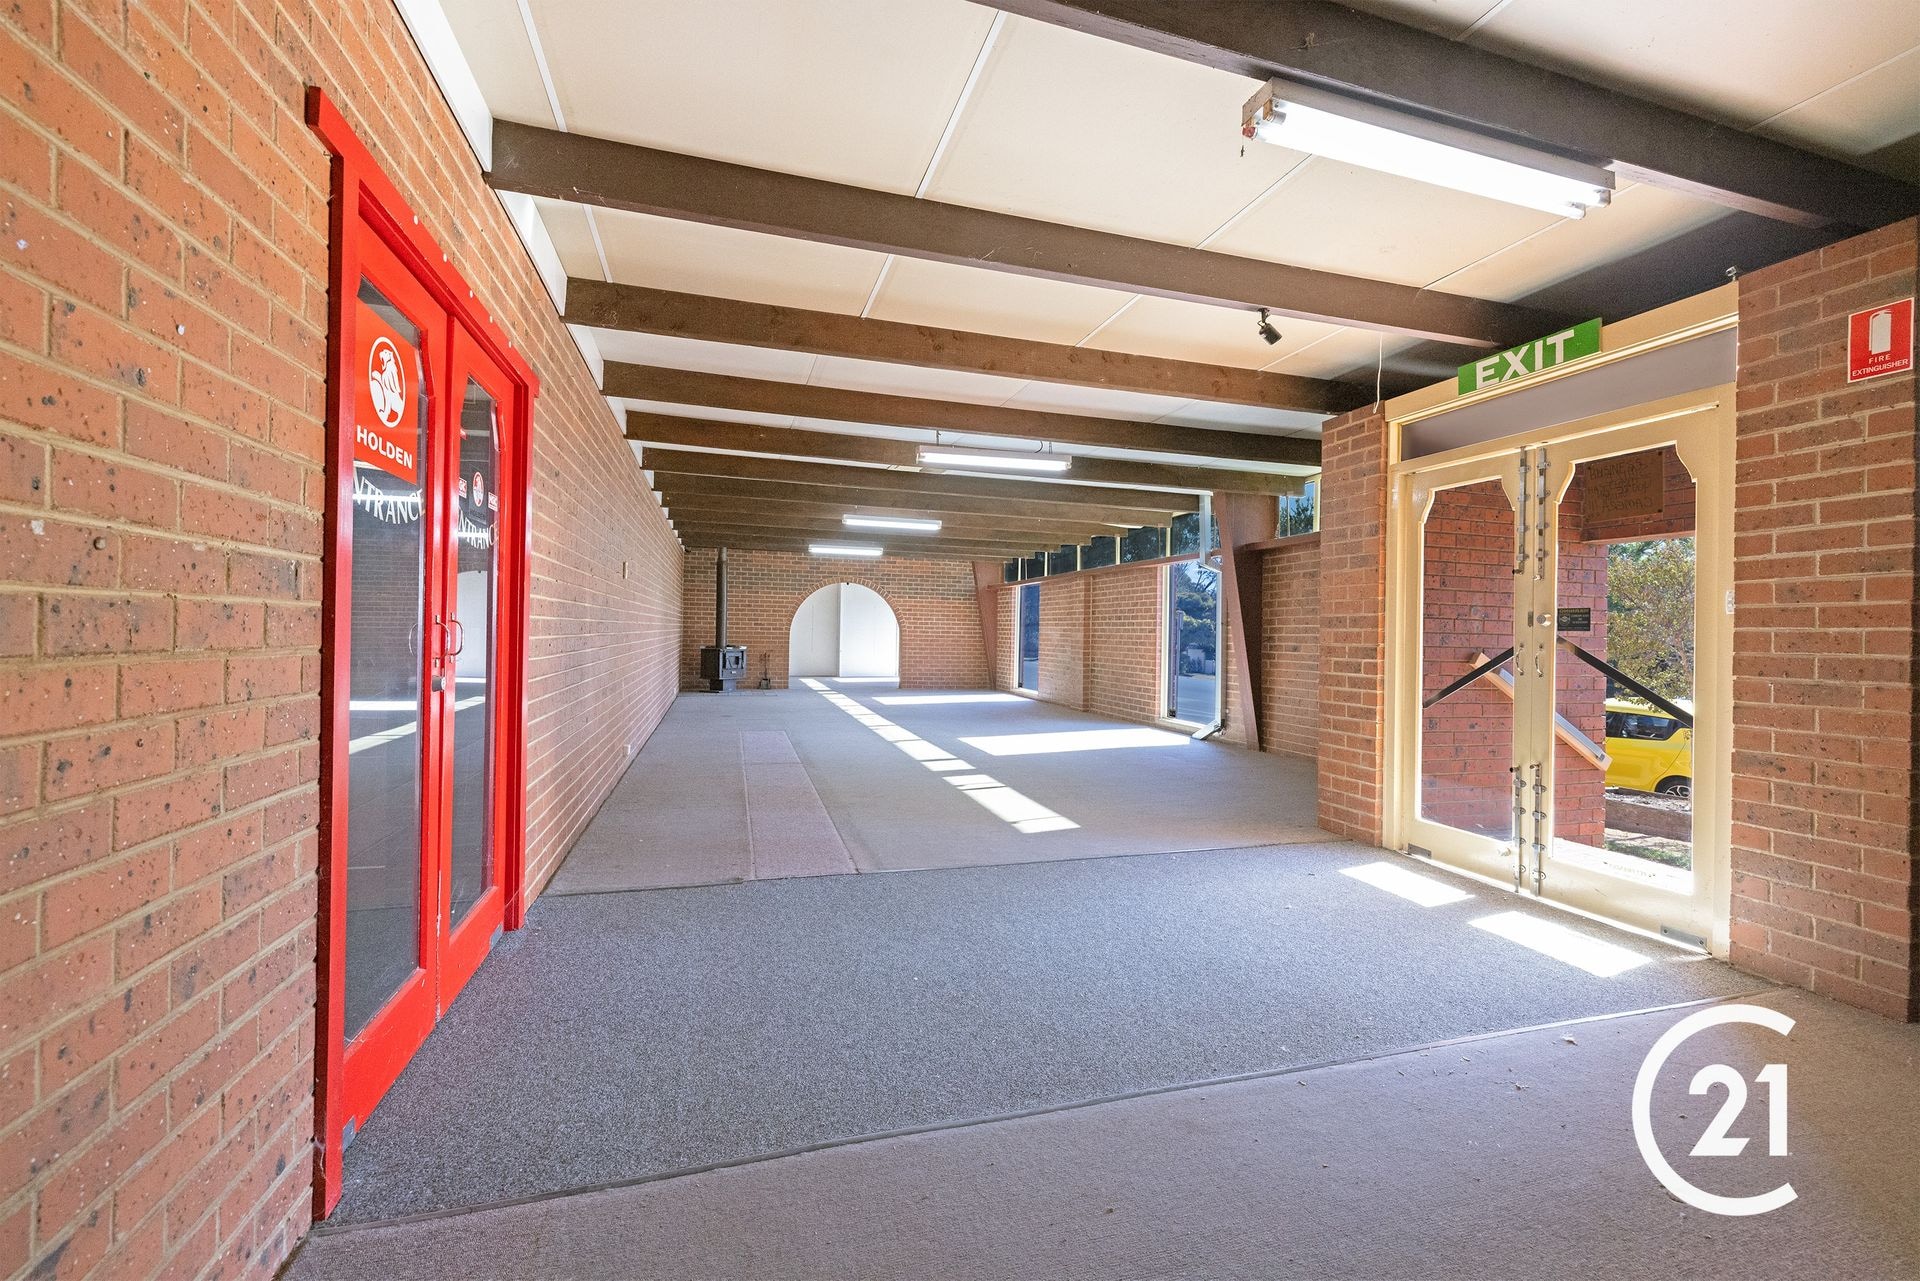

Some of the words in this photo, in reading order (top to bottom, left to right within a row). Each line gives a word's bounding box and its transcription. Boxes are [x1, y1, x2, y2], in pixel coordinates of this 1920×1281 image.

[1476, 329, 1575, 389] EXIT
[1852, 359, 1908, 376] EXTINGUISHER
[1868, 354, 1891, 364] FIRE
[357, 425, 412, 469] HOLDEN
